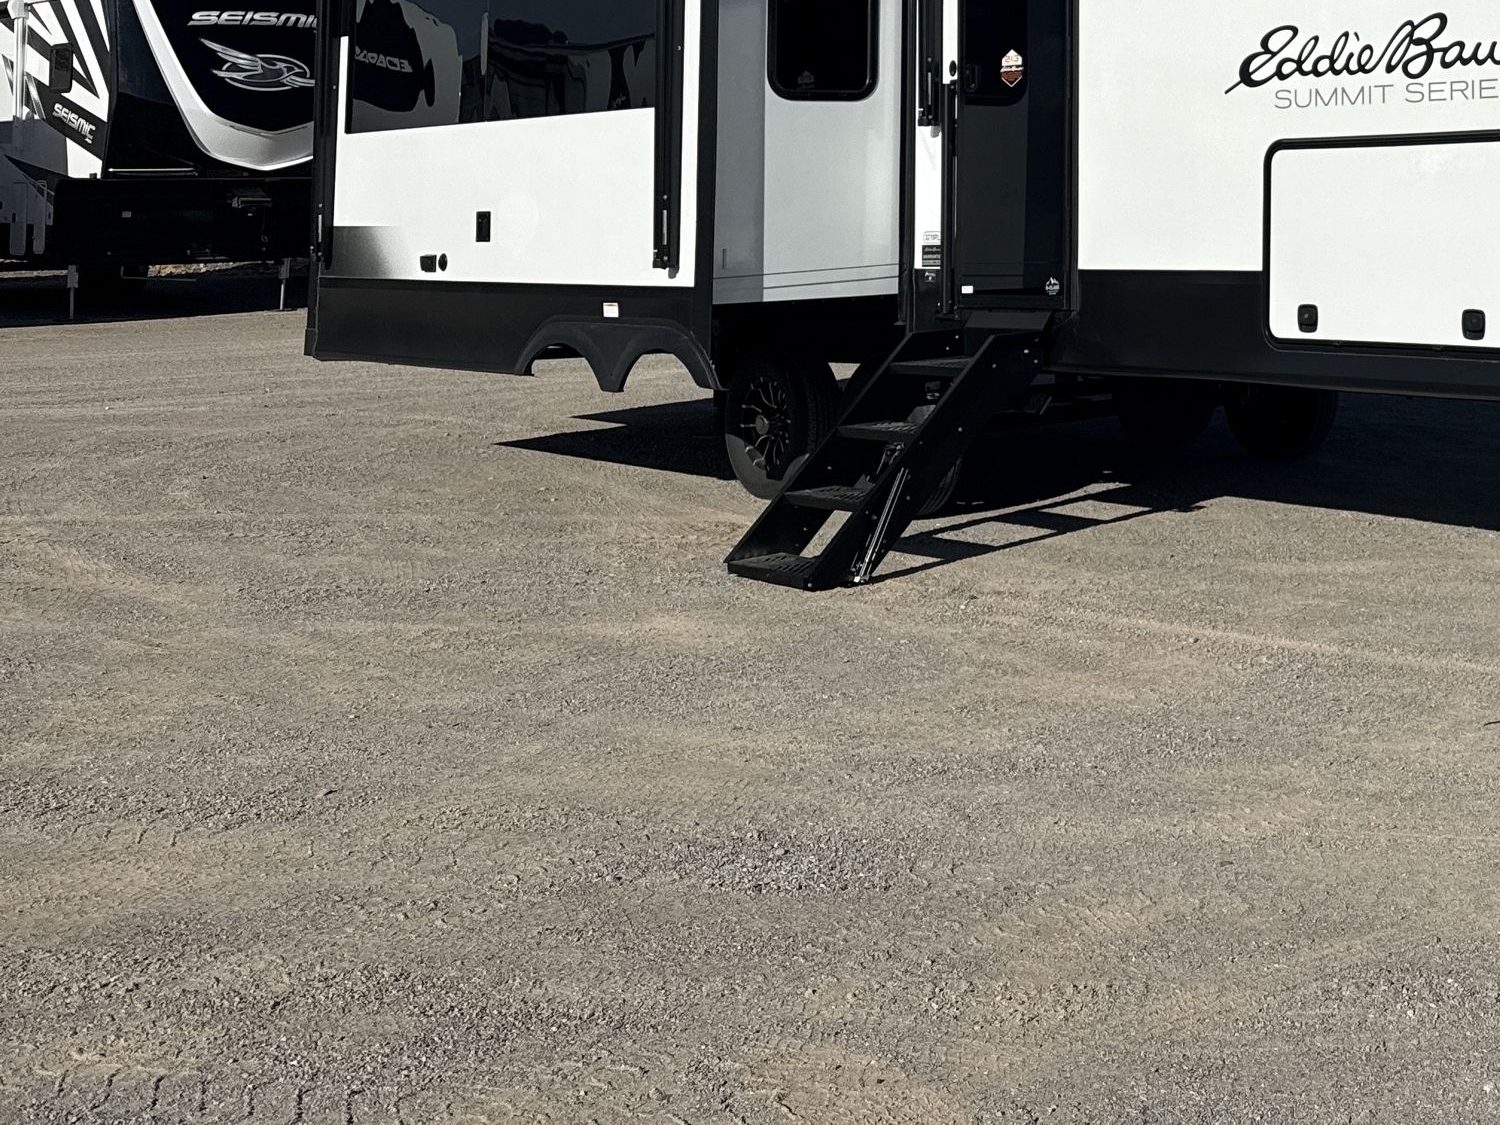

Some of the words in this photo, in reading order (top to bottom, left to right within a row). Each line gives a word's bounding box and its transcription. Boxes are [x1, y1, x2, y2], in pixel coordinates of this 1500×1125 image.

[1224, 25, 1384, 95] Eddie
[1273, 83, 1395, 110] SUMMIT
[52, 102, 96, 140] SEISMIC
